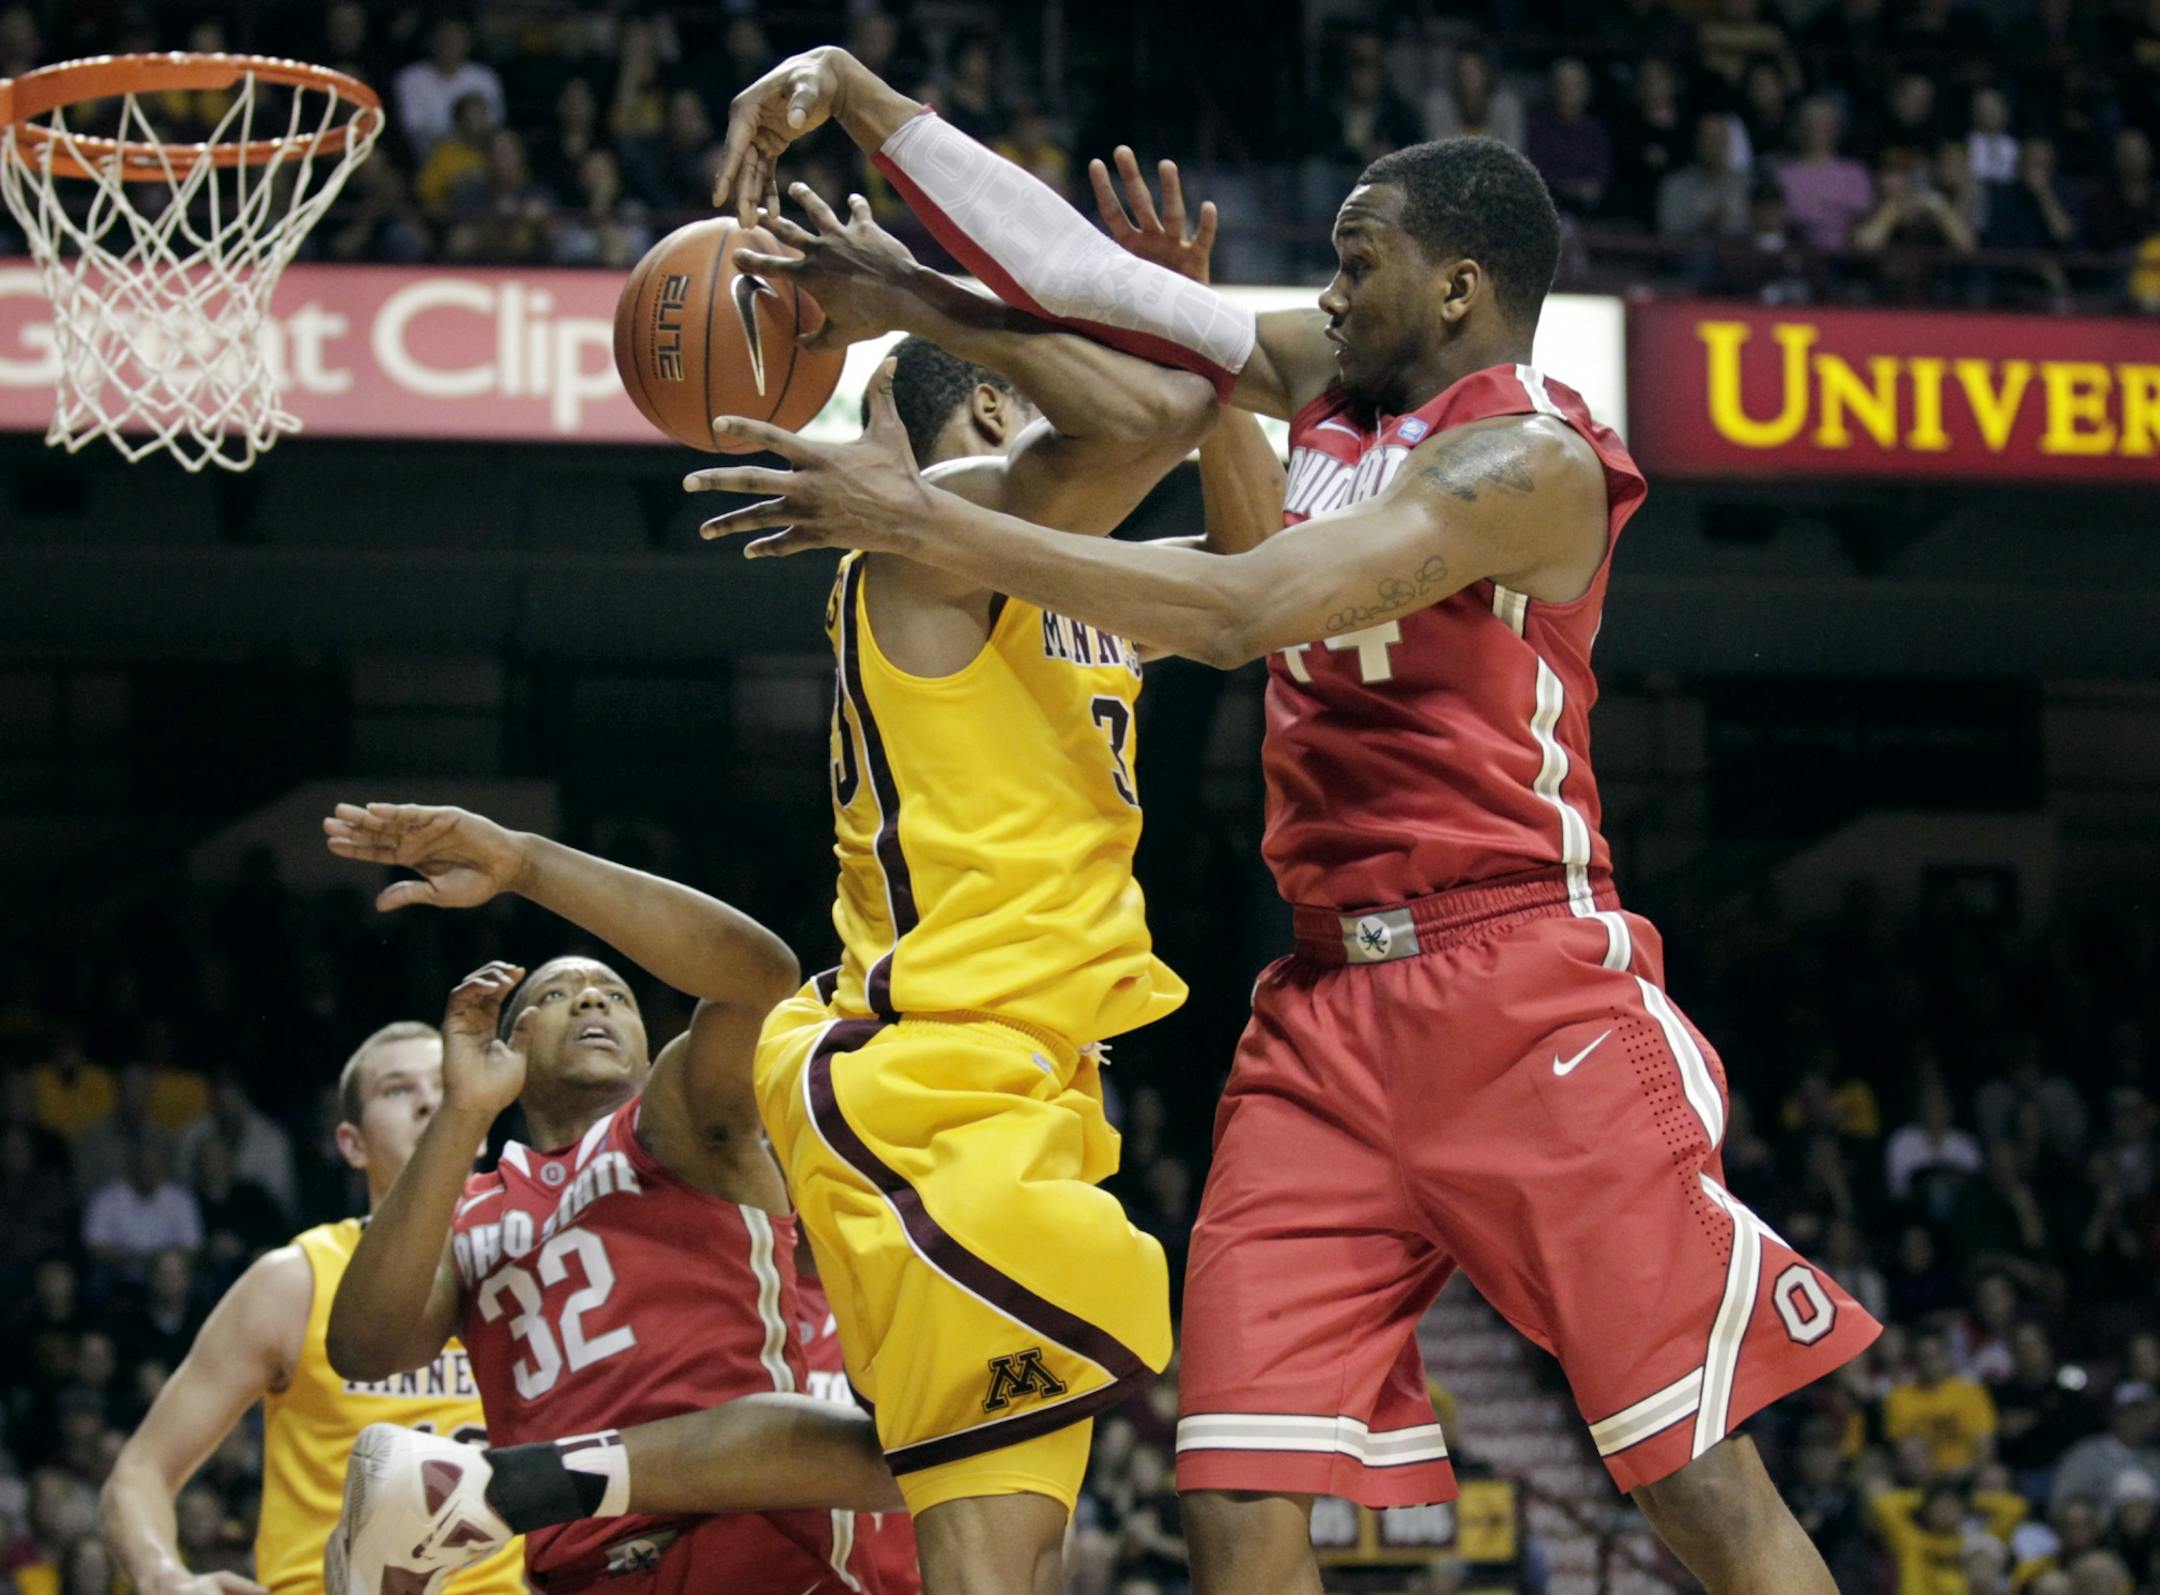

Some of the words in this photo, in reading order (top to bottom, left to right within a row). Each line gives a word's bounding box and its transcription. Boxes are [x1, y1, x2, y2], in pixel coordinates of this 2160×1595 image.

[657, 275, 690, 381] ELITE
[478, 1227, 637, 1400] 32
[982, 1347, 1067, 1413] M
